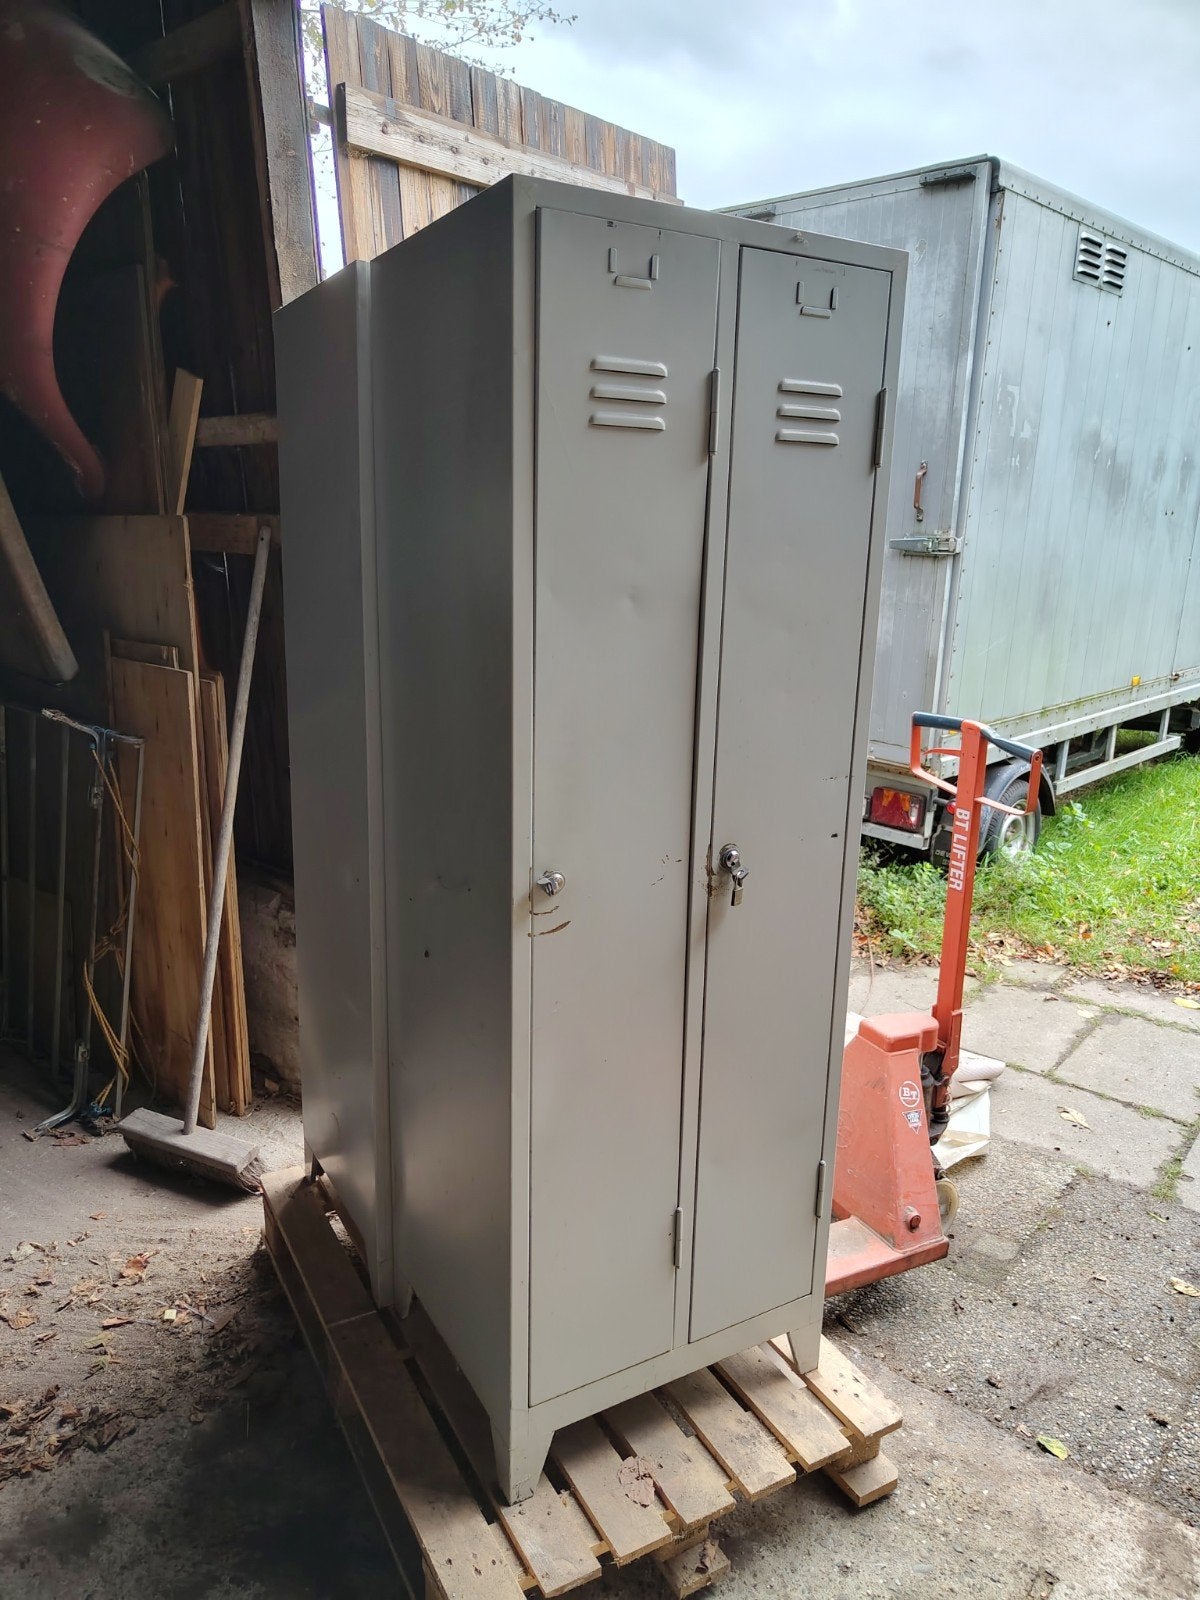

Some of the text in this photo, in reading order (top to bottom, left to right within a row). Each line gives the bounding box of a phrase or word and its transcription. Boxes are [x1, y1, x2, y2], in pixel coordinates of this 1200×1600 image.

[949, 808, 970, 891] BT LIFTER
[902, 1087, 918, 1100] BT
